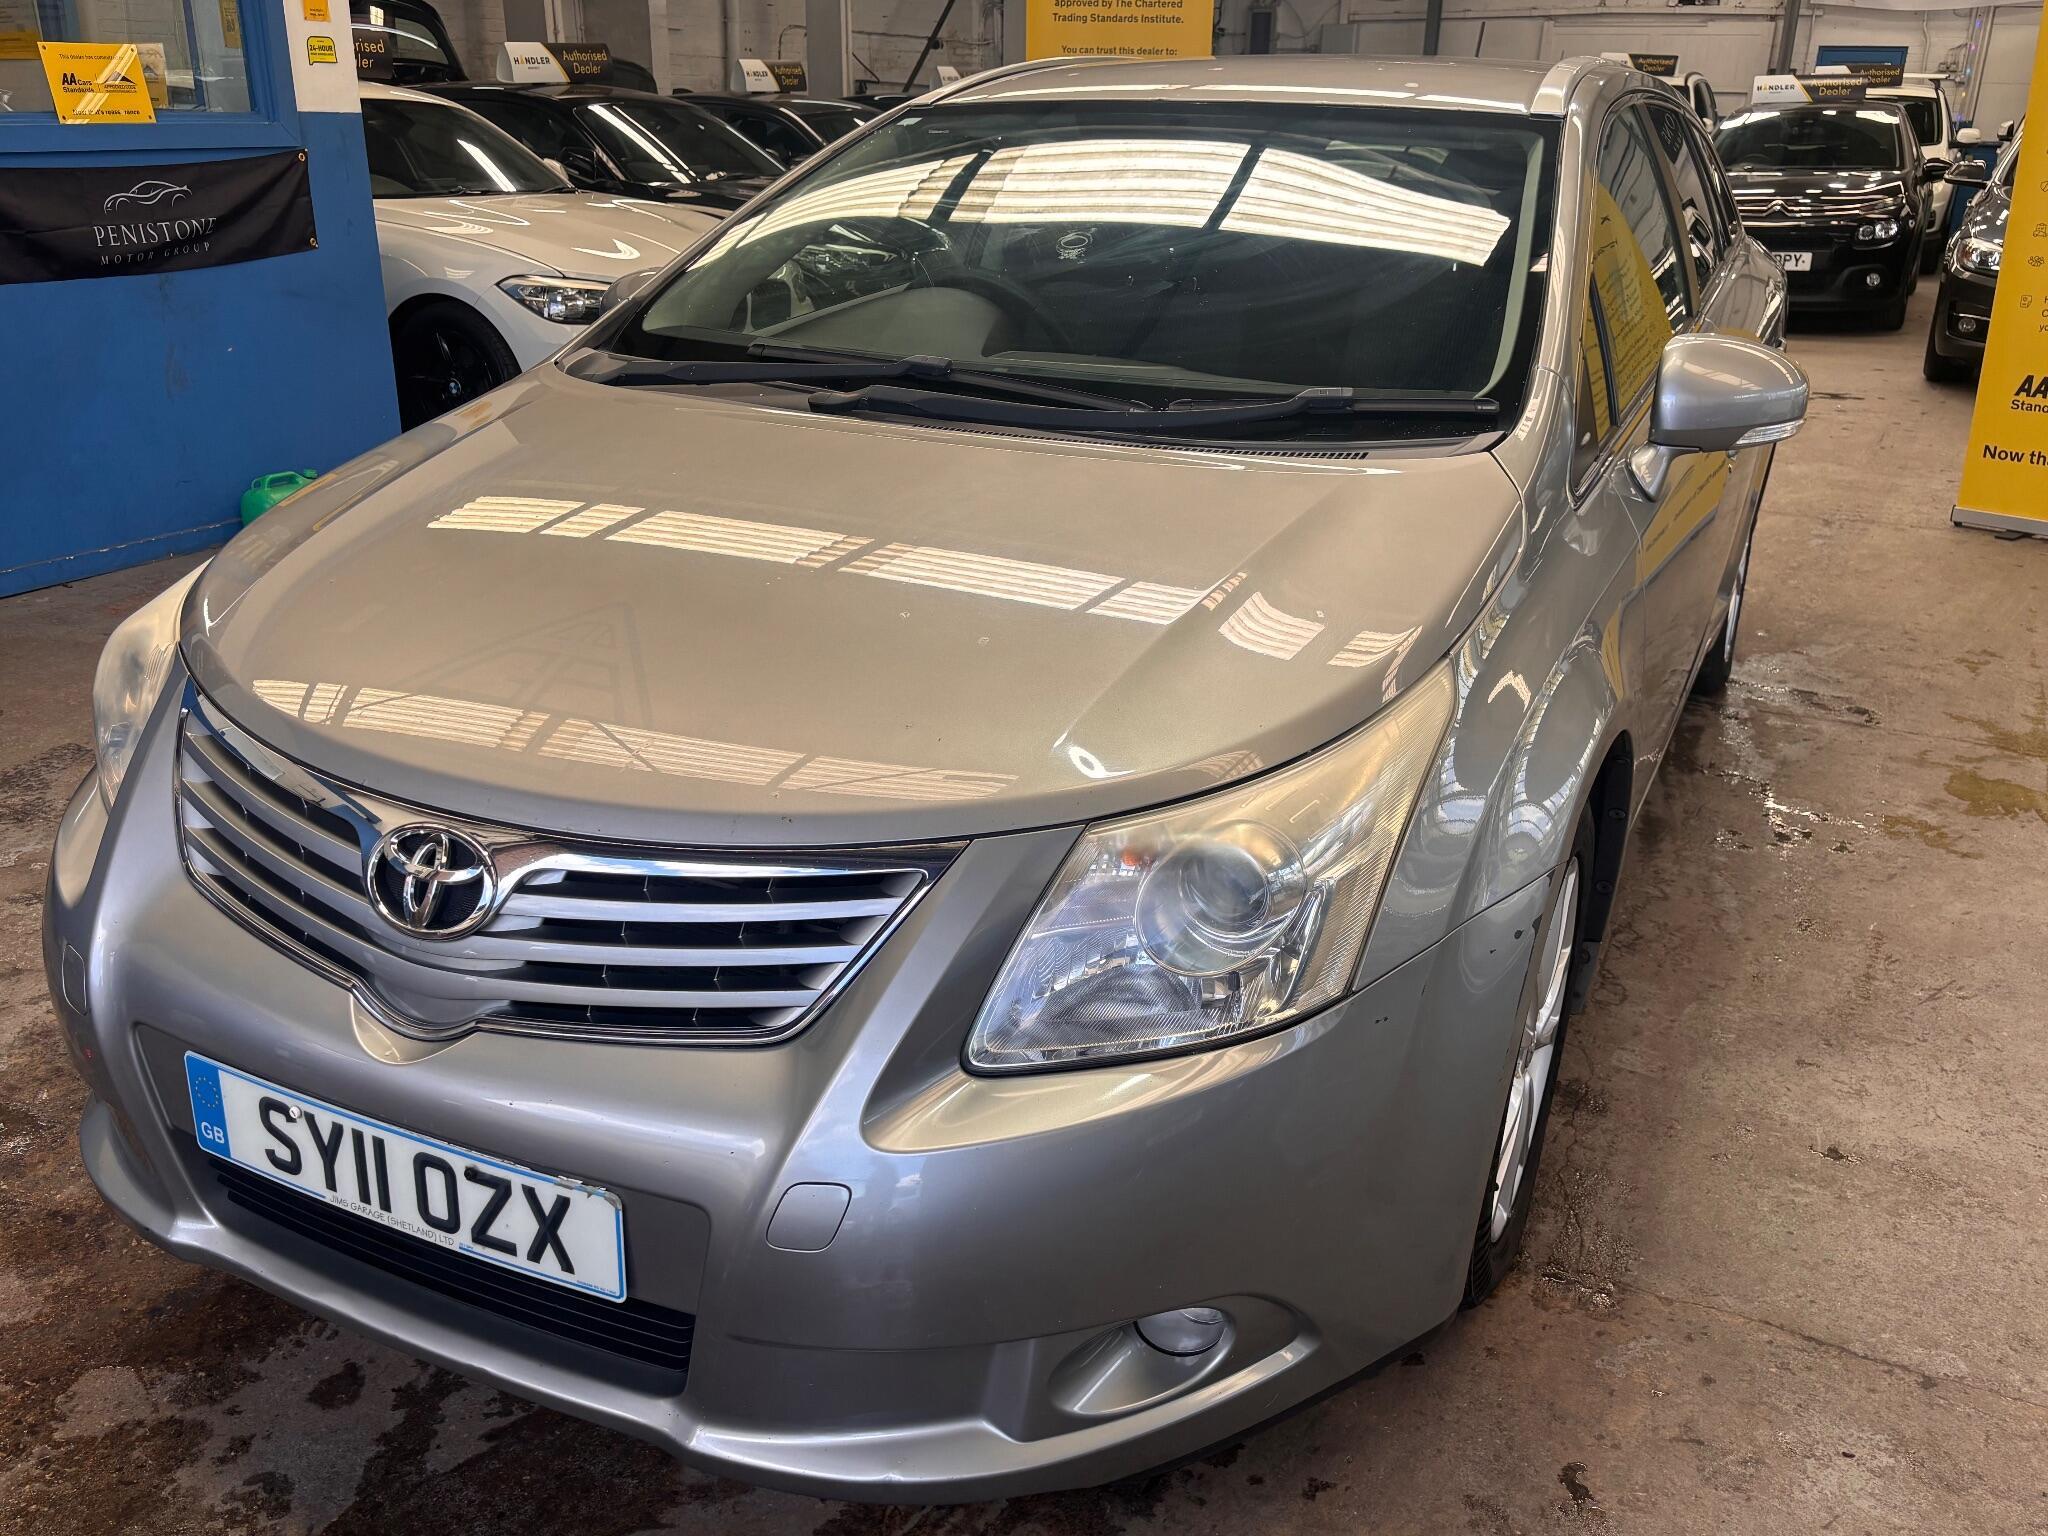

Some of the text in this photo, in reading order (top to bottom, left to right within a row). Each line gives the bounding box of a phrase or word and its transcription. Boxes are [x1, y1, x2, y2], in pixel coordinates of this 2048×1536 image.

[1054, 0, 1183, 9] approved by The Chartered
[1053, 13, 1184, 24] Trading Standards Institute.
[563, 50, 608, 61] Authorised
[1061, 45, 1077, 54] You
[1096, 46, 1117, 54] trust
[1118, 46, 1135, 55] this
[1136, 46, 1163, 55] dealer
[1165, 47, 1177, 56] to:
[573, 63, 601, 74] Dealer
[62, 72, 78, 86] AA
[1811, 77, 1863, 87] Authorised
[1819, 86, 1851, 96] Dealer
[93, 217, 217, 247] PENISTONE
[100, 241, 210, 266] MOTOR GROUP
[1983, 444, 2048, 467] Now th
[200, 1120, 225, 1145] GB
[259, 1096, 575, 1275] SY11 OZX
[330, 1197, 349, 1208] JIMS
[350, 1202, 386, 1222] GARAGE
[387, 1215, 437, 1242] (SHETLAND)
[439, 1236, 455, 1247] LTD
